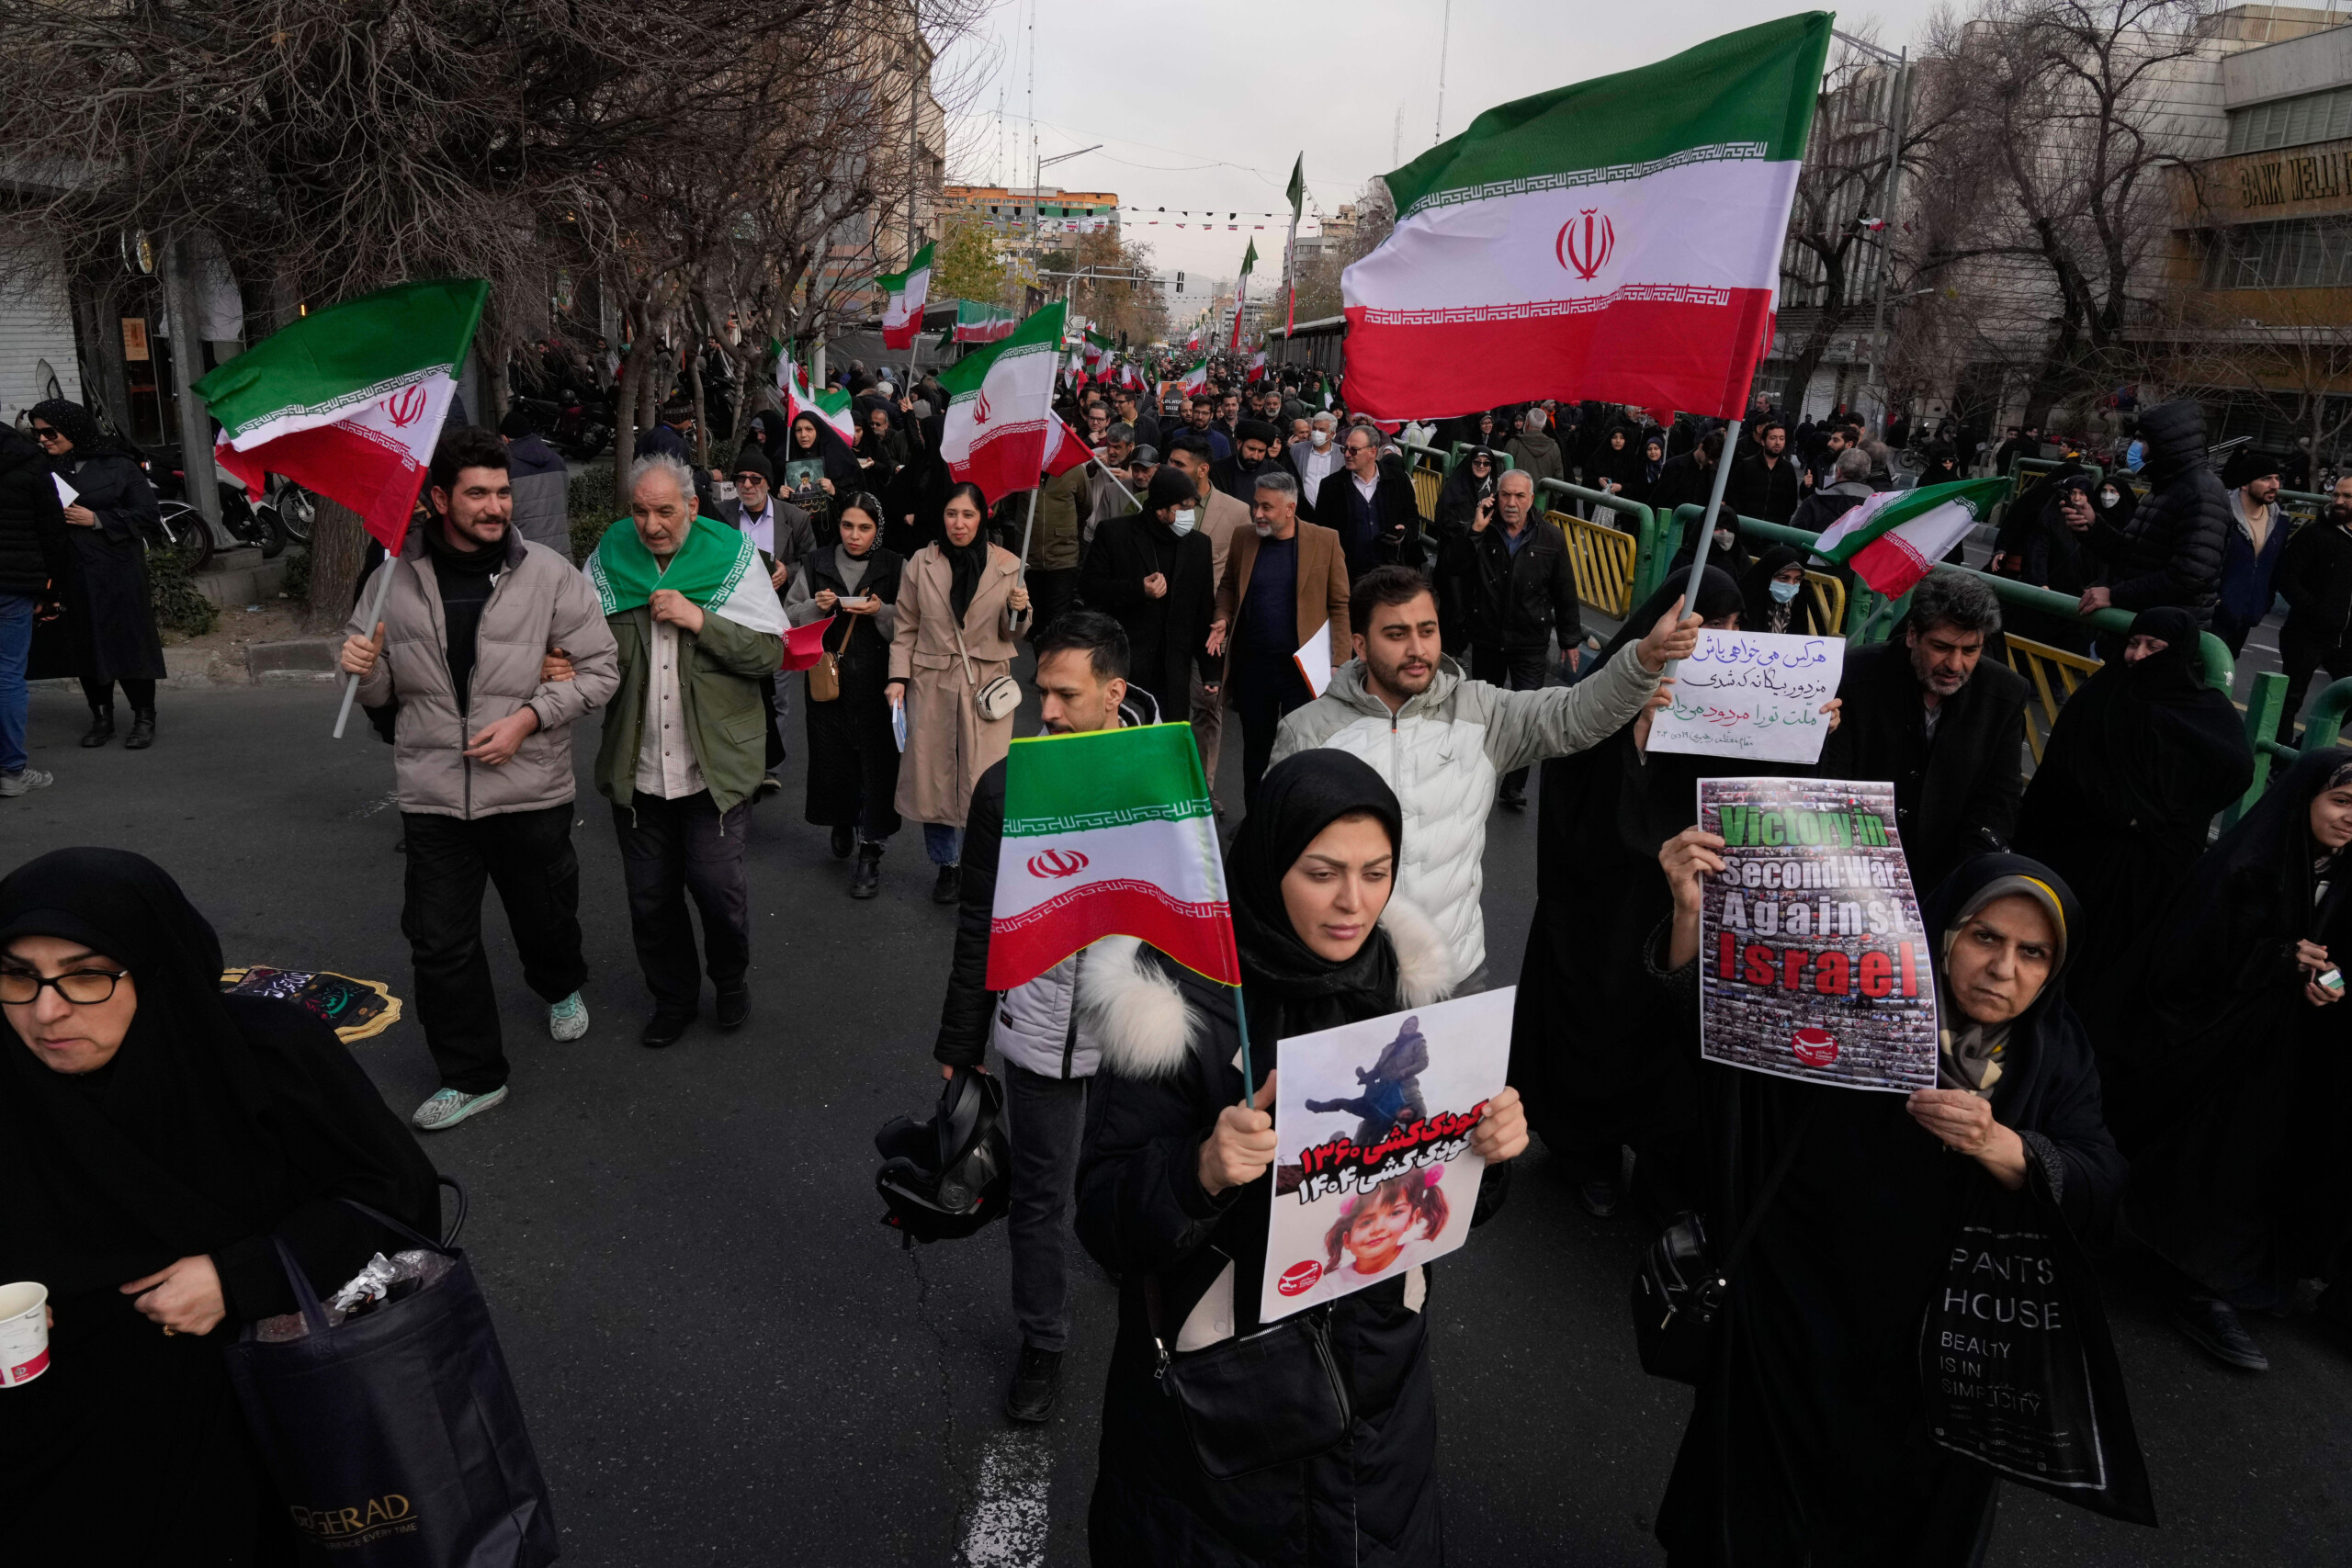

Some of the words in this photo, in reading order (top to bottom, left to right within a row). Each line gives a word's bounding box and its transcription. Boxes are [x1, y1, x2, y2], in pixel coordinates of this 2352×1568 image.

[2240, 163, 2286, 208] BANK
[2287, 154, 2339, 200] MELLI
[1702, 706, 1750, 727] مردود
[1719, 806, 1853, 849] Victory
[1853, 807, 1890, 847] in
[1721, 855, 1840, 889] Second
[1843, 855, 1897, 888] War
[1721, 890, 1909, 937] Against
[1719, 931, 1917, 998] Israel
[1949, 1247, 2055, 1285] PANTS
[1943, 1287, 2062, 1330] HOUSE
[1939, 1356, 1956, 1373] IS
[1962, 1360, 1982, 1378] IN
[1940, 1378, 2041, 1416] SIMPLICITY
[312, 1494, 410, 1535] GERAD
[363, 1528, 392, 1543] EVERY
[394, 1522, 418, 1534] TIME
